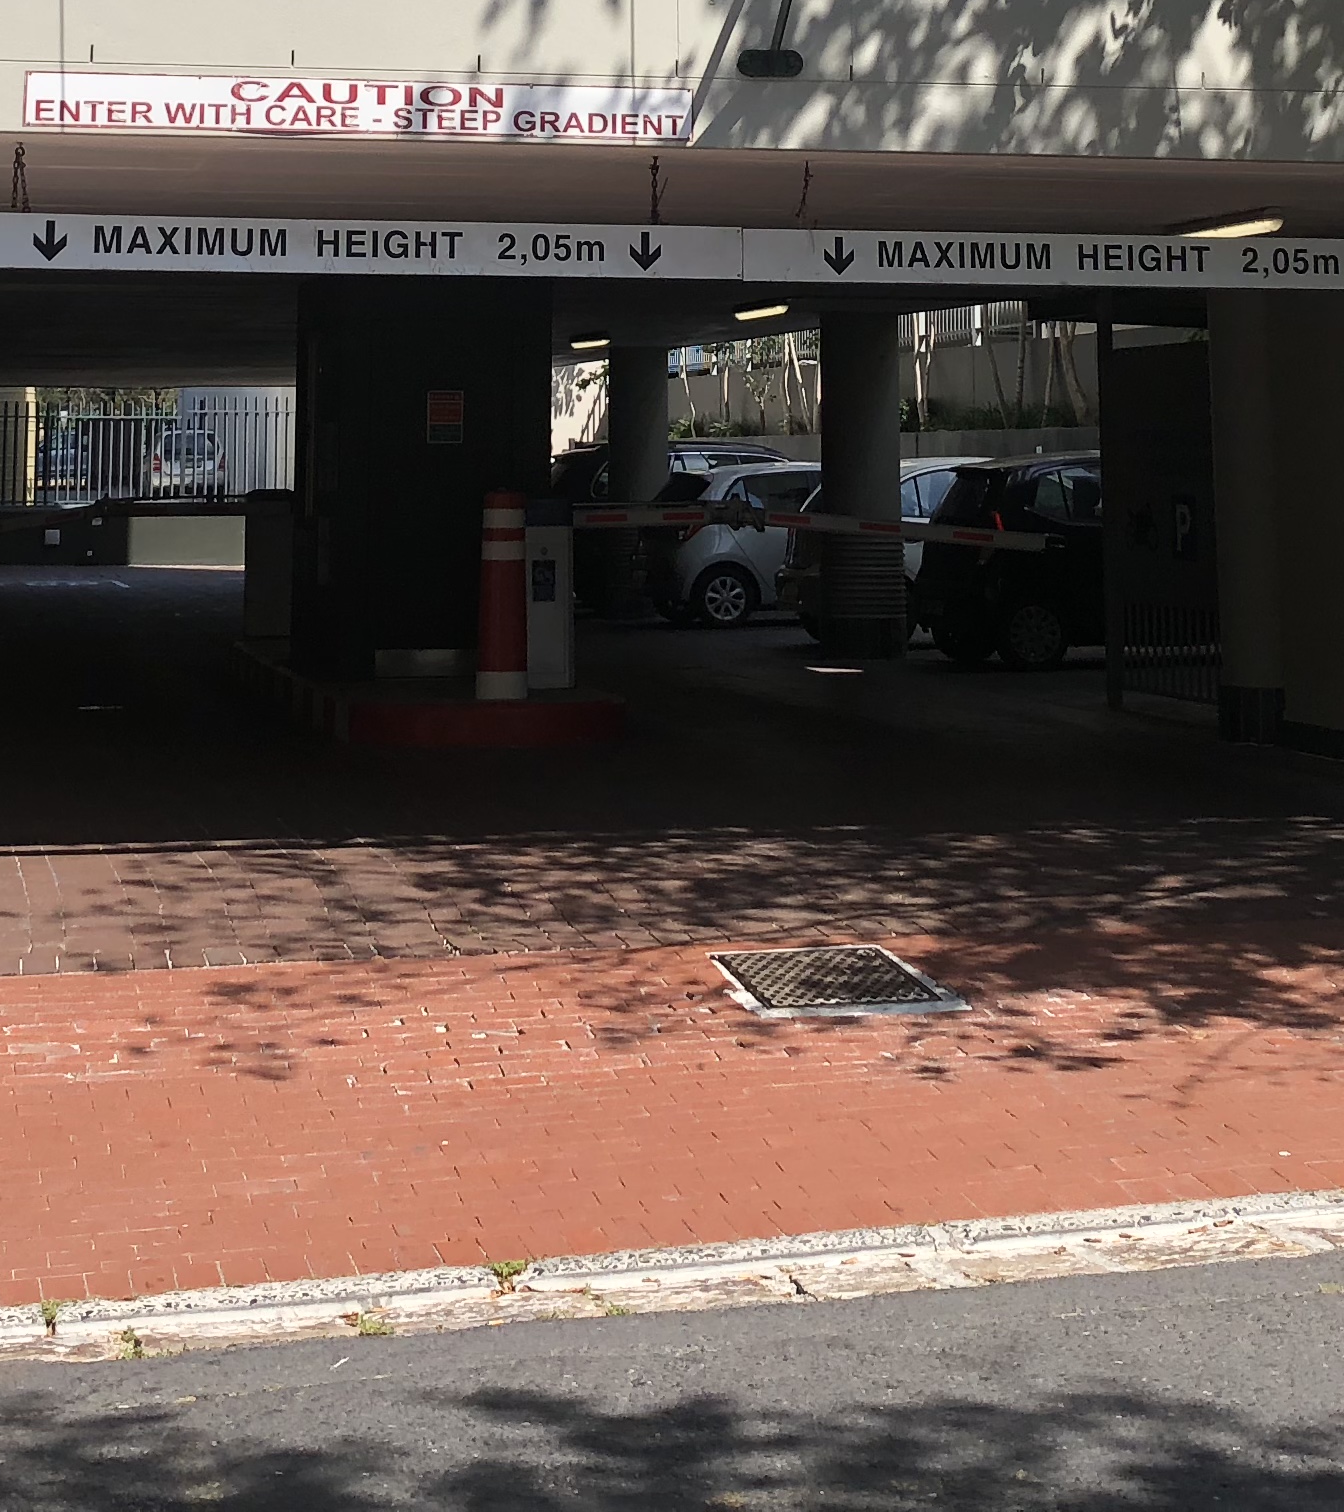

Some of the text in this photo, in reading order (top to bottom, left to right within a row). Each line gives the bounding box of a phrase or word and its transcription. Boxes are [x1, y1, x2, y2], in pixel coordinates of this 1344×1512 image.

[230, 80, 505, 108] CAUTION
[33, 98, 153, 125] ENTER
[165, 100, 253, 127] WITH
[264, 102, 361, 130] CARE
[392, 106, 502, 133] STEEP
[512, 109, 685, 138] GRADIENT
[92, 225, 606, 265] MAXIMUM HEIGHT 2,05m
[876, 240, 1341, 280] MAXIMUM HEIGHT 2,05m
